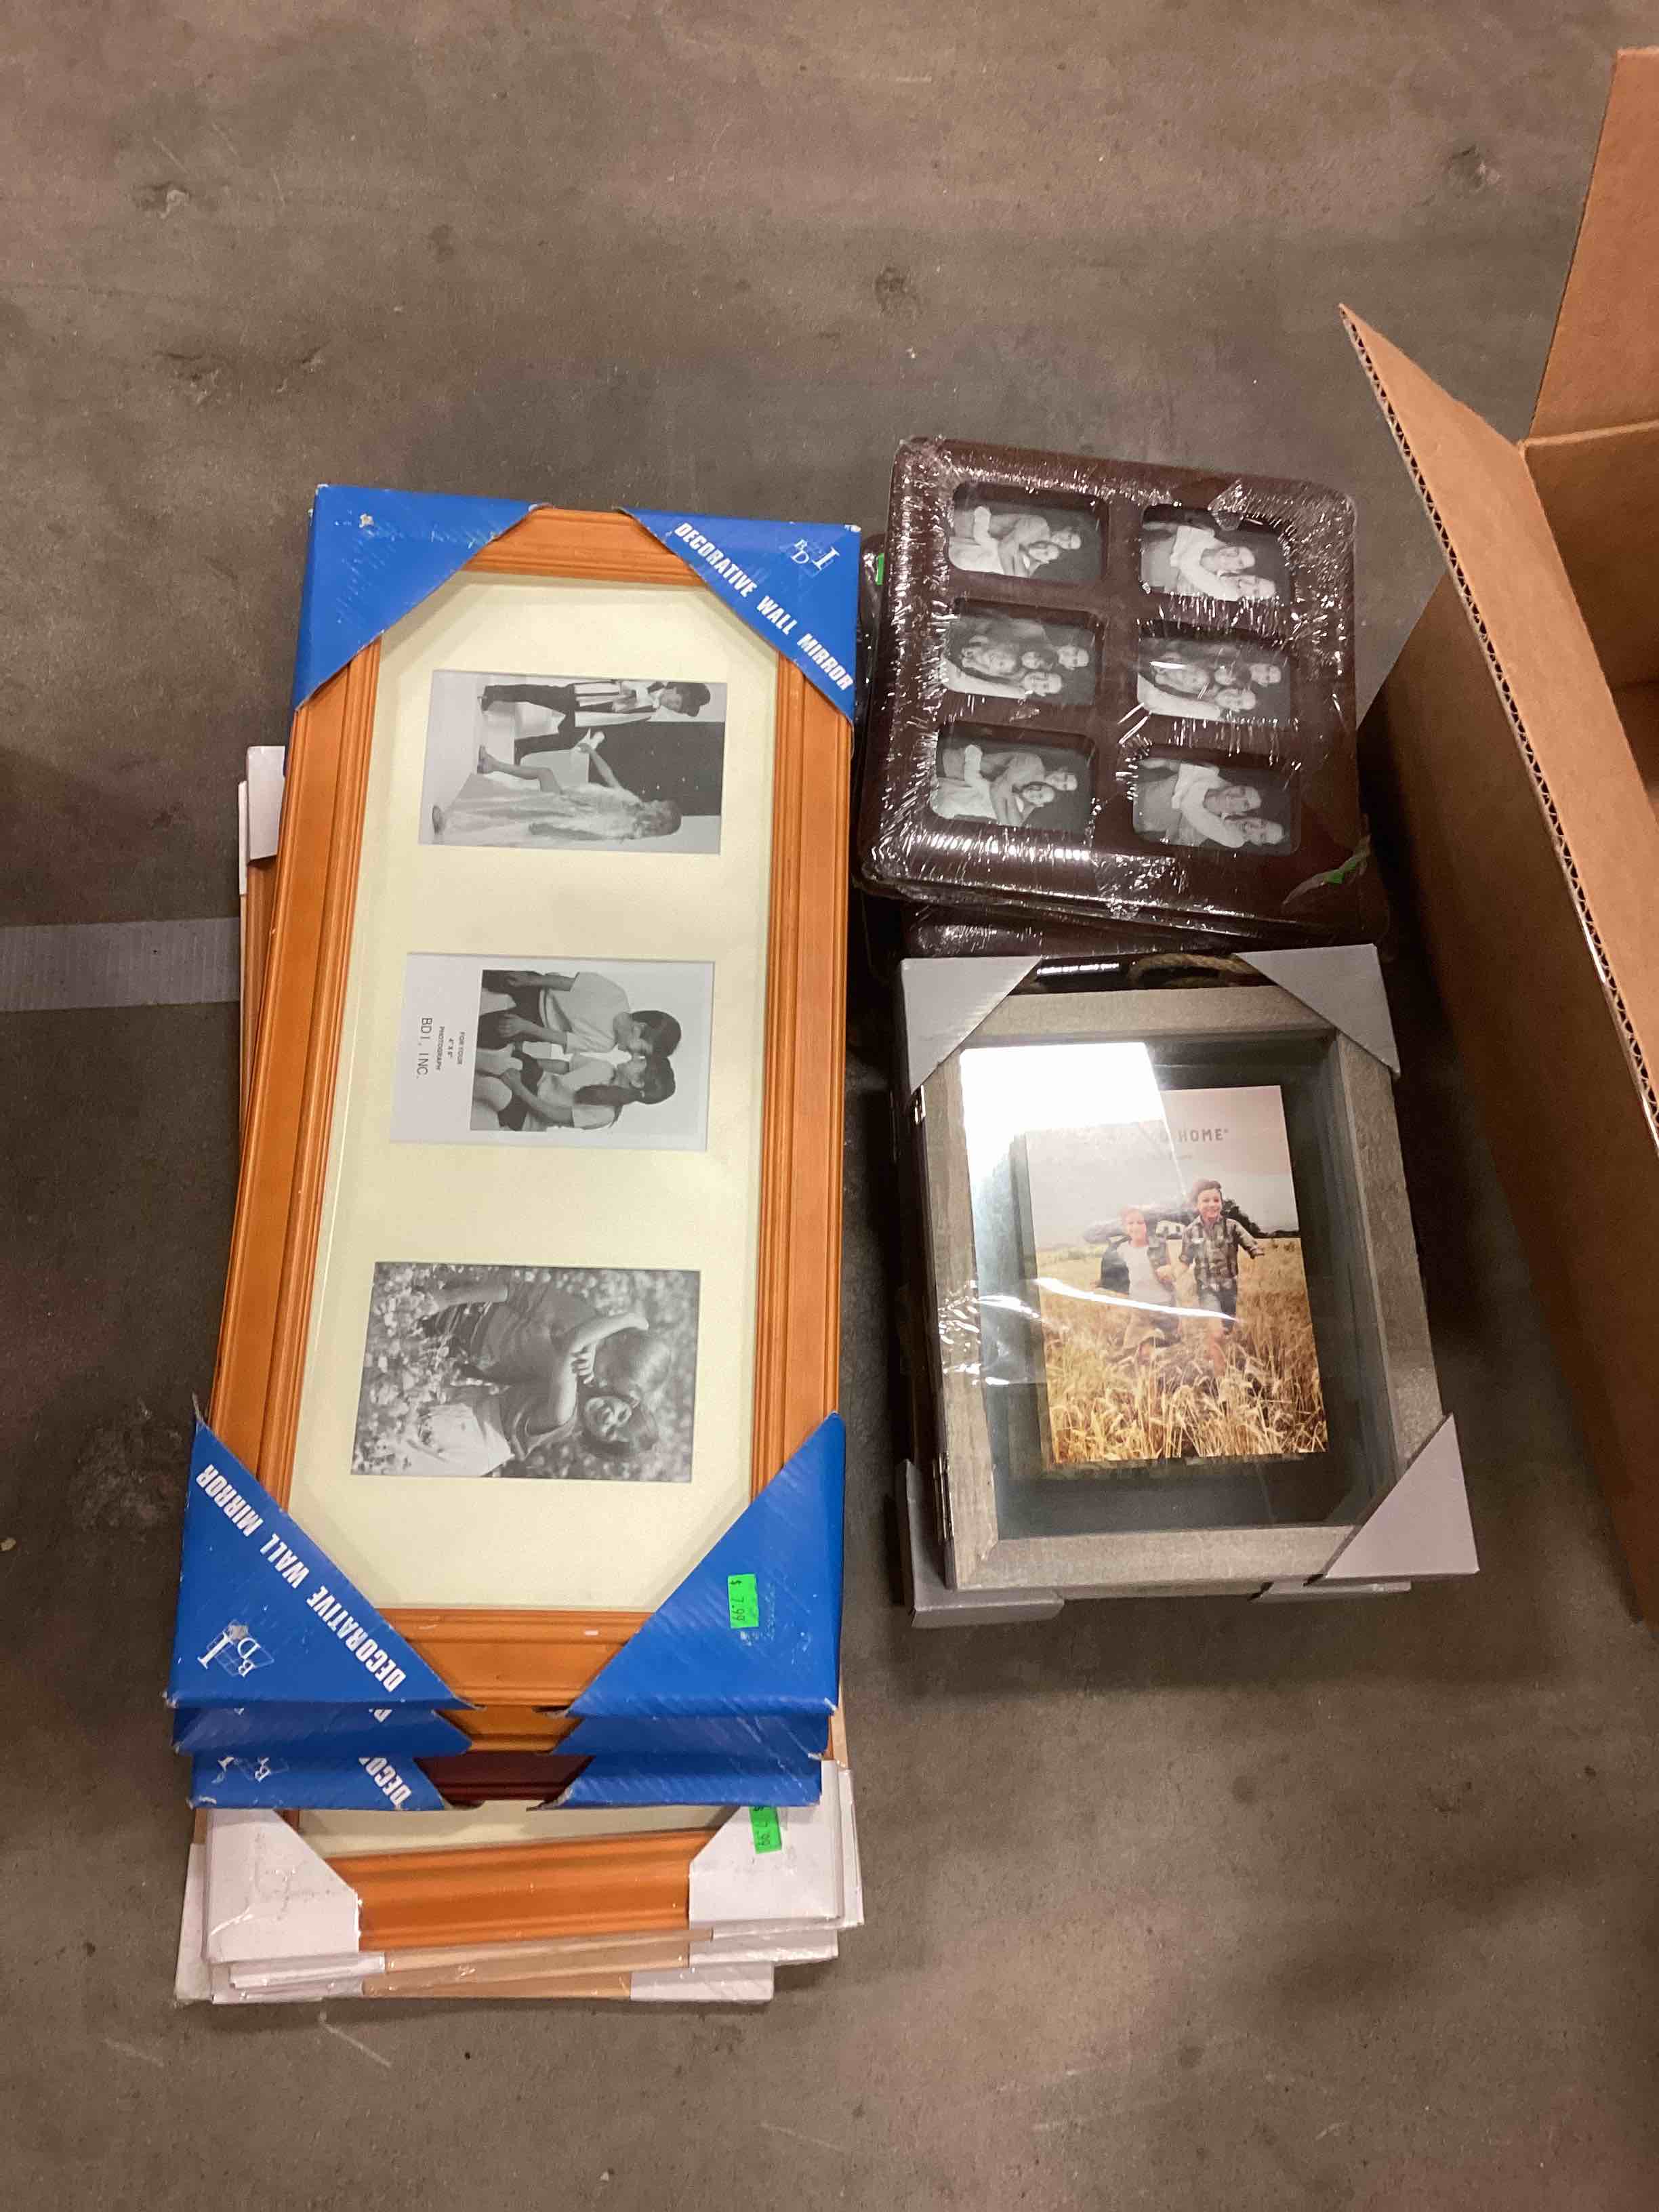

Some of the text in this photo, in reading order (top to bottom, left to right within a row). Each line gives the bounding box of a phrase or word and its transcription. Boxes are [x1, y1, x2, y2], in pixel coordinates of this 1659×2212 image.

[674, 523, 854, 690] DECORATIVE WALL MIRROR
[416, 1052, 430, 1079] INC.
[436, 1026, 445, 1071] PHOTOGRAPH
[195, 1464, 407, 1692] DECORATIVE WALL MIRROR
